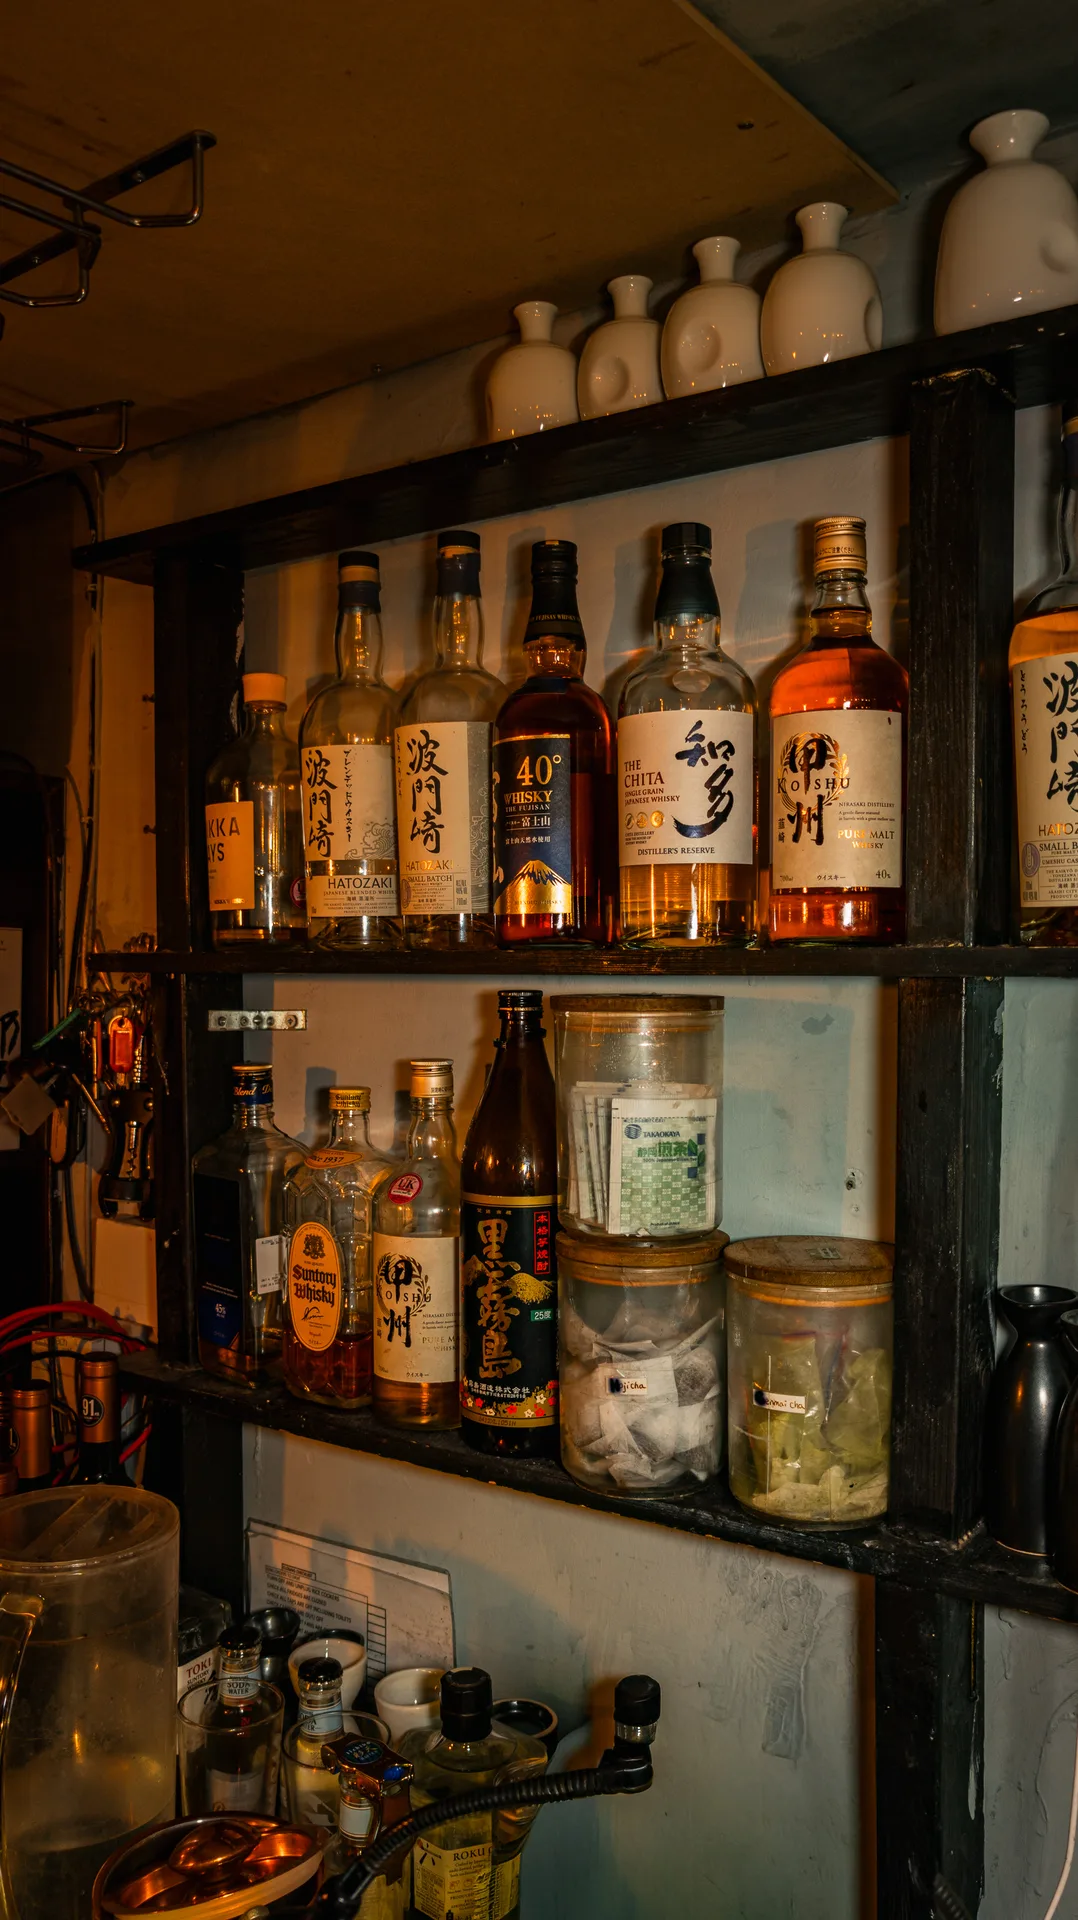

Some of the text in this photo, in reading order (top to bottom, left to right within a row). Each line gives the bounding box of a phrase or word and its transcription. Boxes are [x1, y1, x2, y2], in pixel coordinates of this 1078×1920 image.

[624, 759, 641, 772] THE
[624, 771, 665, 788] CHITA
[671, 719, 736, 839] 知多
[777, 777, 850, 794] KOSHU
[406, 729, 449, 854] 波門崎
[504, 789, 553, 805] WHISKY
[624, 787, 664, 798] SINGLE GRAIN
[787, 737, 829, 846] 甲州
[305, 749, 338, 857] 波門崎
[624, 795, 680, 807] JAPANESE WHISKY
[518, 804, 550, 812] FUJISAN
[521, 815, 551, 828] 富士山
[870, 830, 895, 840] MALT
[637, 847, 679, 856] DISTILLER'S
[1039, 842, 1069, 852] SMALL
[328, 877, 392, 889] HATOZAKI
[233, 1086, 257, 1097] Blend
[535, 1213, 549, 1272] 本格芋焼酎
[292, 1264, 337, 1289] Suntory
[293, 1282, 335, 1308] Whisky
[476, 1217, 522, 1379] 黒霧島
[383, 1260, 412, 1348] 甲州
[534, 1310, 552, 1320] 25度
[422, 1336, 445, 1344] PURE
[789, 1400, 805, 1410] cha
[311, 1595, 327, 1606] CLOSED
[321, 1591, 340, 1602] COOKERS
[313, 1606, 335, 1618] INCLUDING
[186, 1657, 212, 1679] TOKI
[187, 1669, 210, 1685] SUNTORY
[226, 1681, 251, 1689] SODA
[453, 1848, 485, 1861] ROKU
